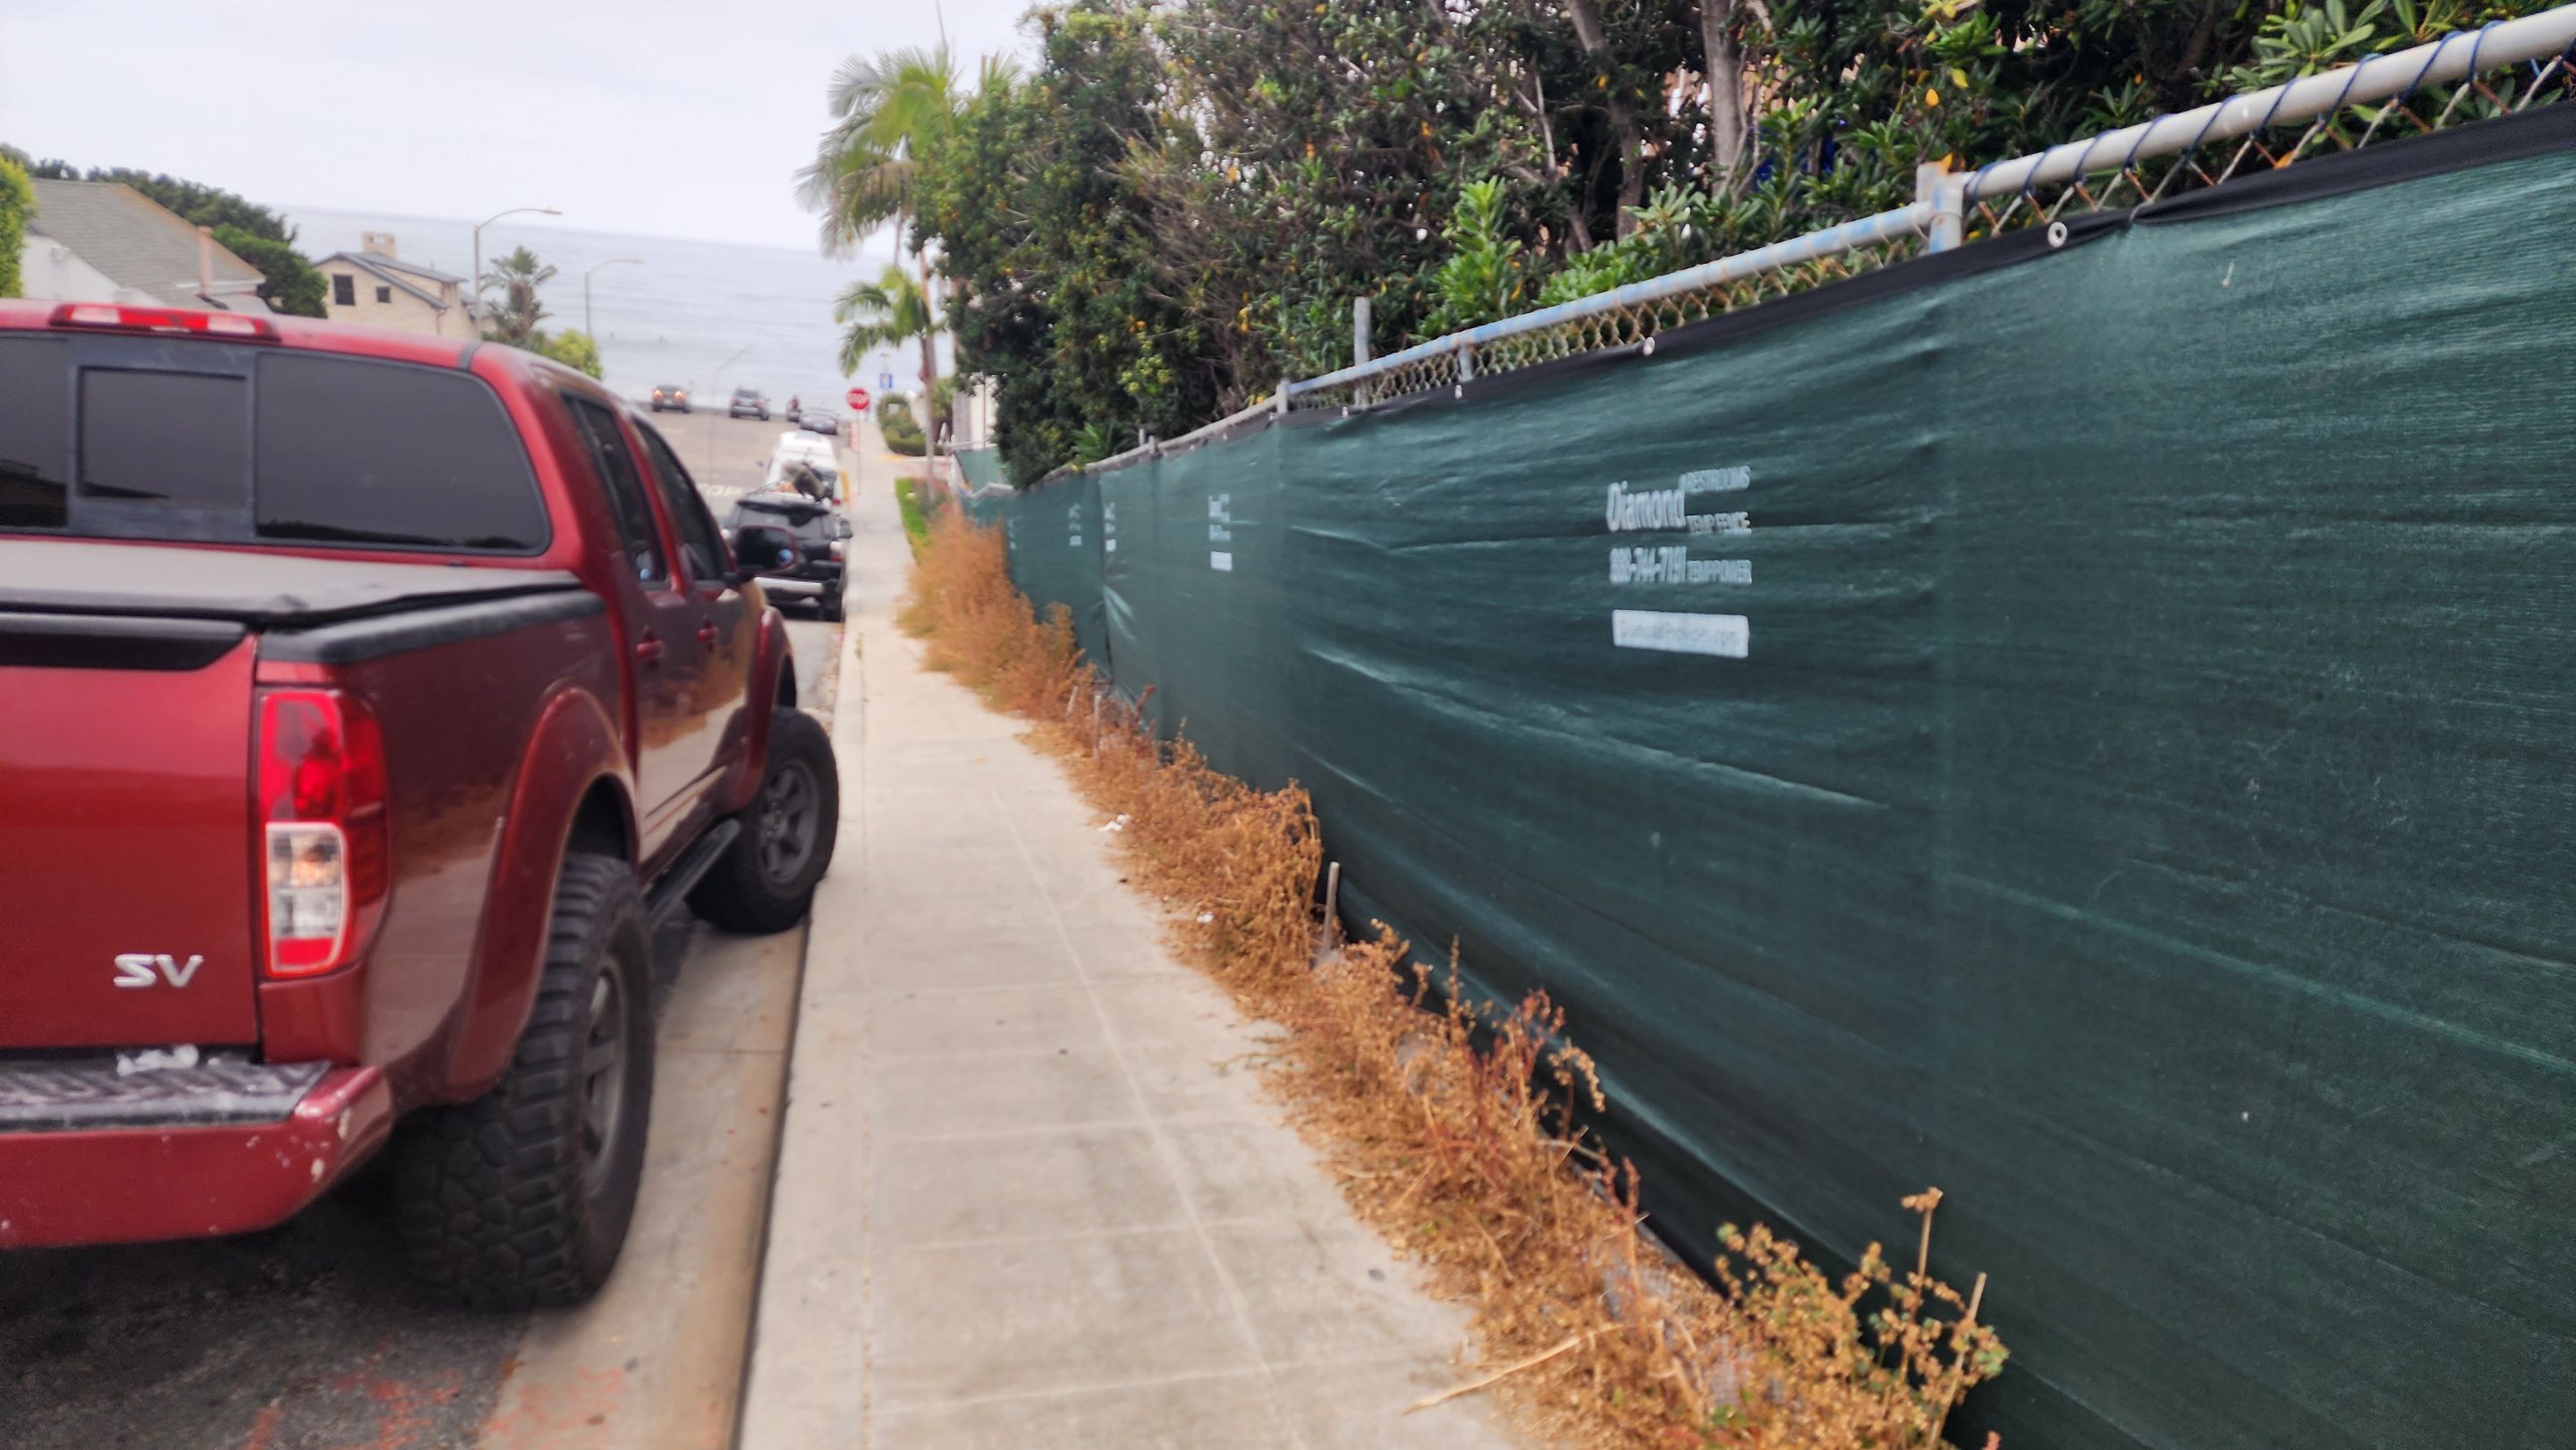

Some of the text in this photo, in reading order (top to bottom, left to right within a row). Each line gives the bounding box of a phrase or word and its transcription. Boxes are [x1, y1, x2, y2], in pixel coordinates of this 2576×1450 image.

[847, 393, 869, 403] STOP
[1606, 480, 1687, 531] Diamond
[114, 954, 204, 988] SV
